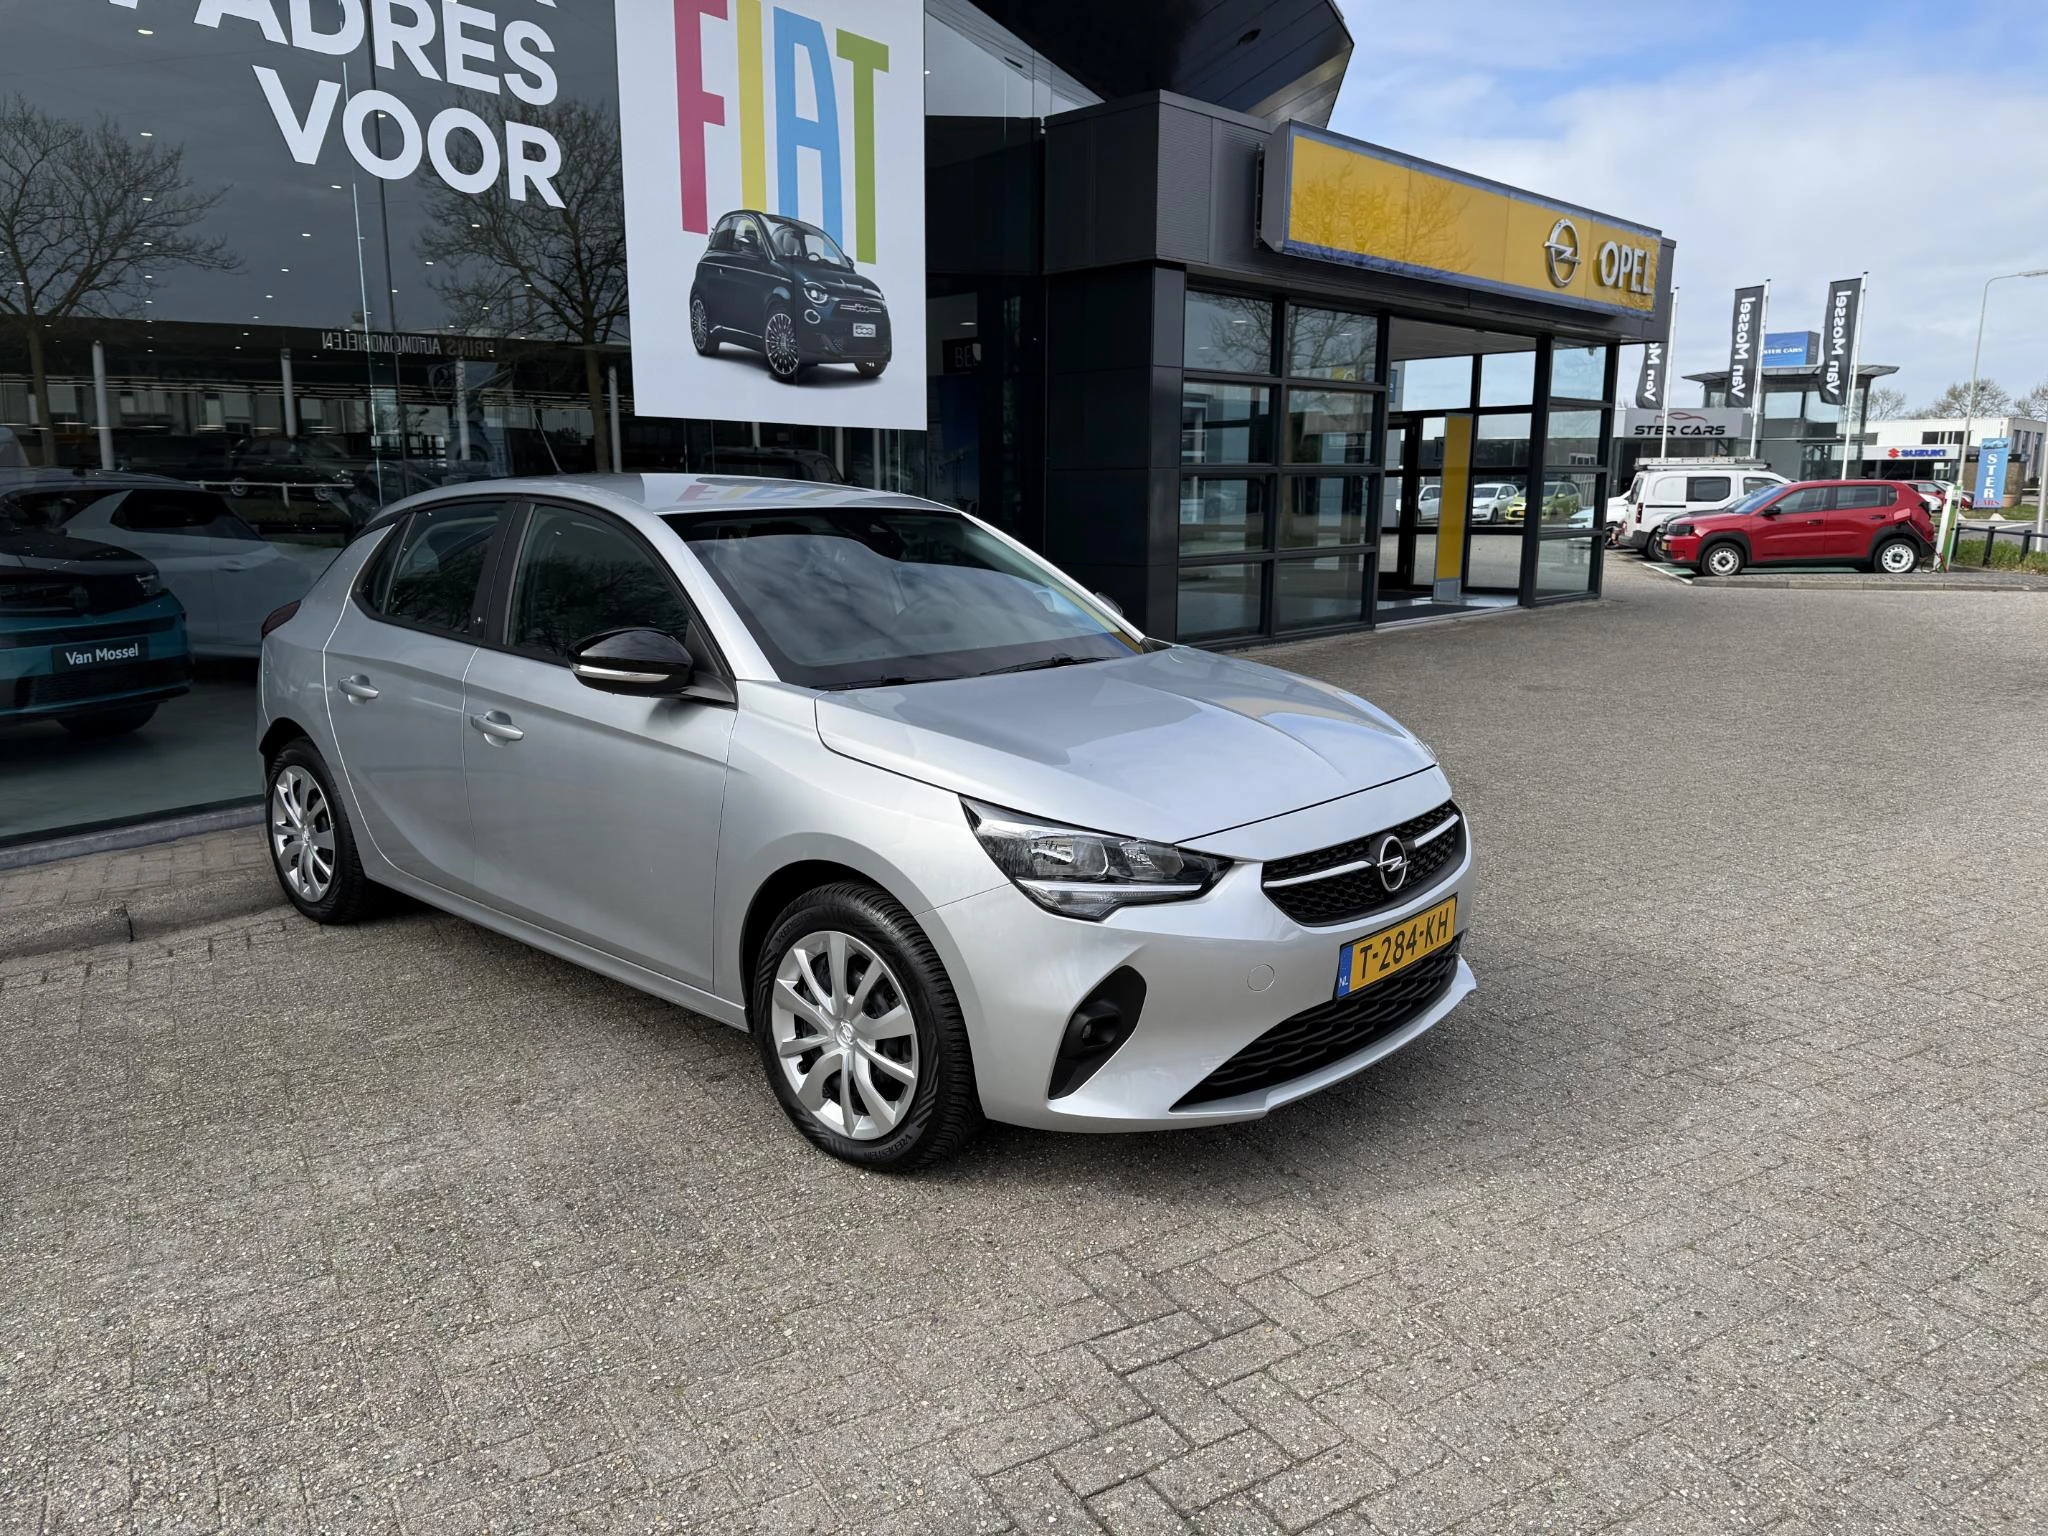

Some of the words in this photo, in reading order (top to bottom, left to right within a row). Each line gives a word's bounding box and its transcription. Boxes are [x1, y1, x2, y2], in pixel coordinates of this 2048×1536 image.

[252, 65, 566, 209] VOOR
[674, 0, 889, 264] FIAT
[1599, 240, 1653, 295] OPEL
[1634, 425, 1676, 436] STER
[1680, 425, 1726, 436] CARS
[1901, 449, 1946, 457] SUZUKI
[1983, 453, 1998, 499] STER
[65, 652, 92, 665] Van
[96, 643, 139, 662] Mossel
[1360, 908, 1449, 979] T-284-KH
[1339, 977, 1348, 988] NL
